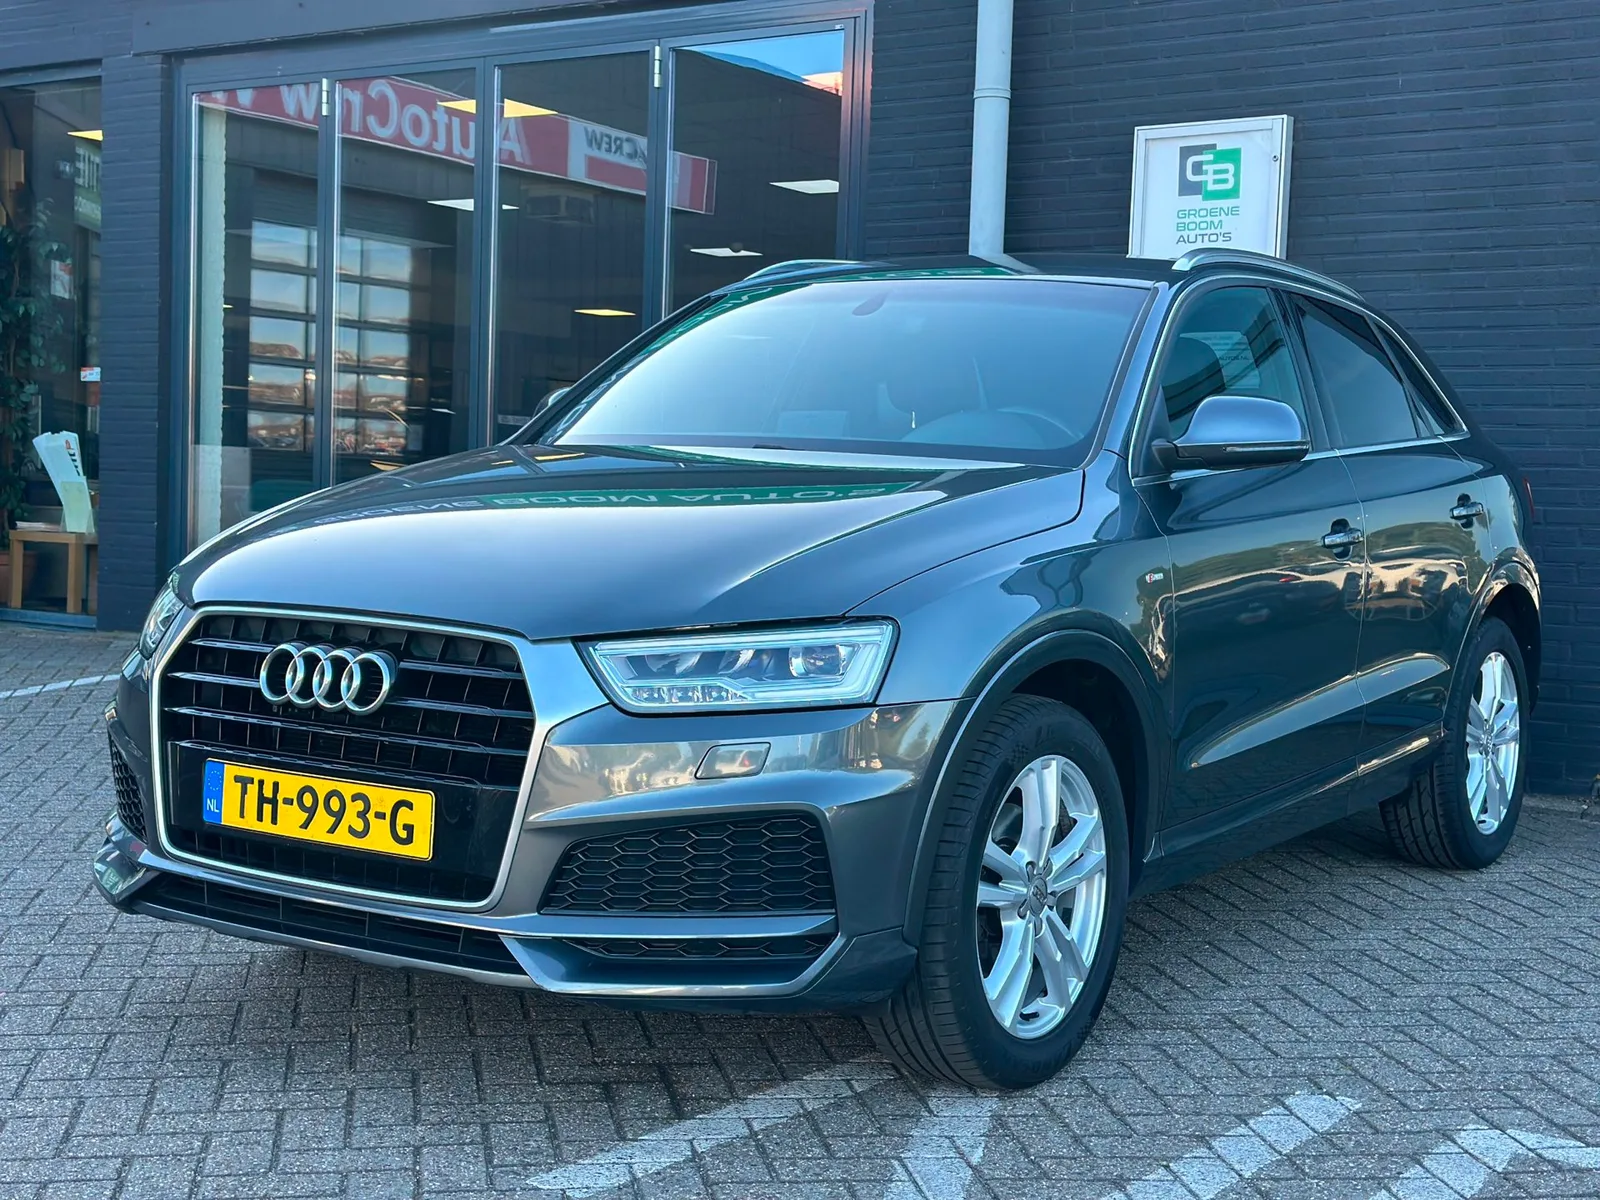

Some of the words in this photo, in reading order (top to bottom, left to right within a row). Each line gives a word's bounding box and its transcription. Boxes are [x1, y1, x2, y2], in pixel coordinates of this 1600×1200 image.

[1176, 206, 1240, 219] GROENE
[1176, 219, 1223, 232] BOOM
[1175, 232, 1232, 245] AUTO'S
[206, 797, 220, 813] NL
[233, 774, 415, 846] TH-993-G
